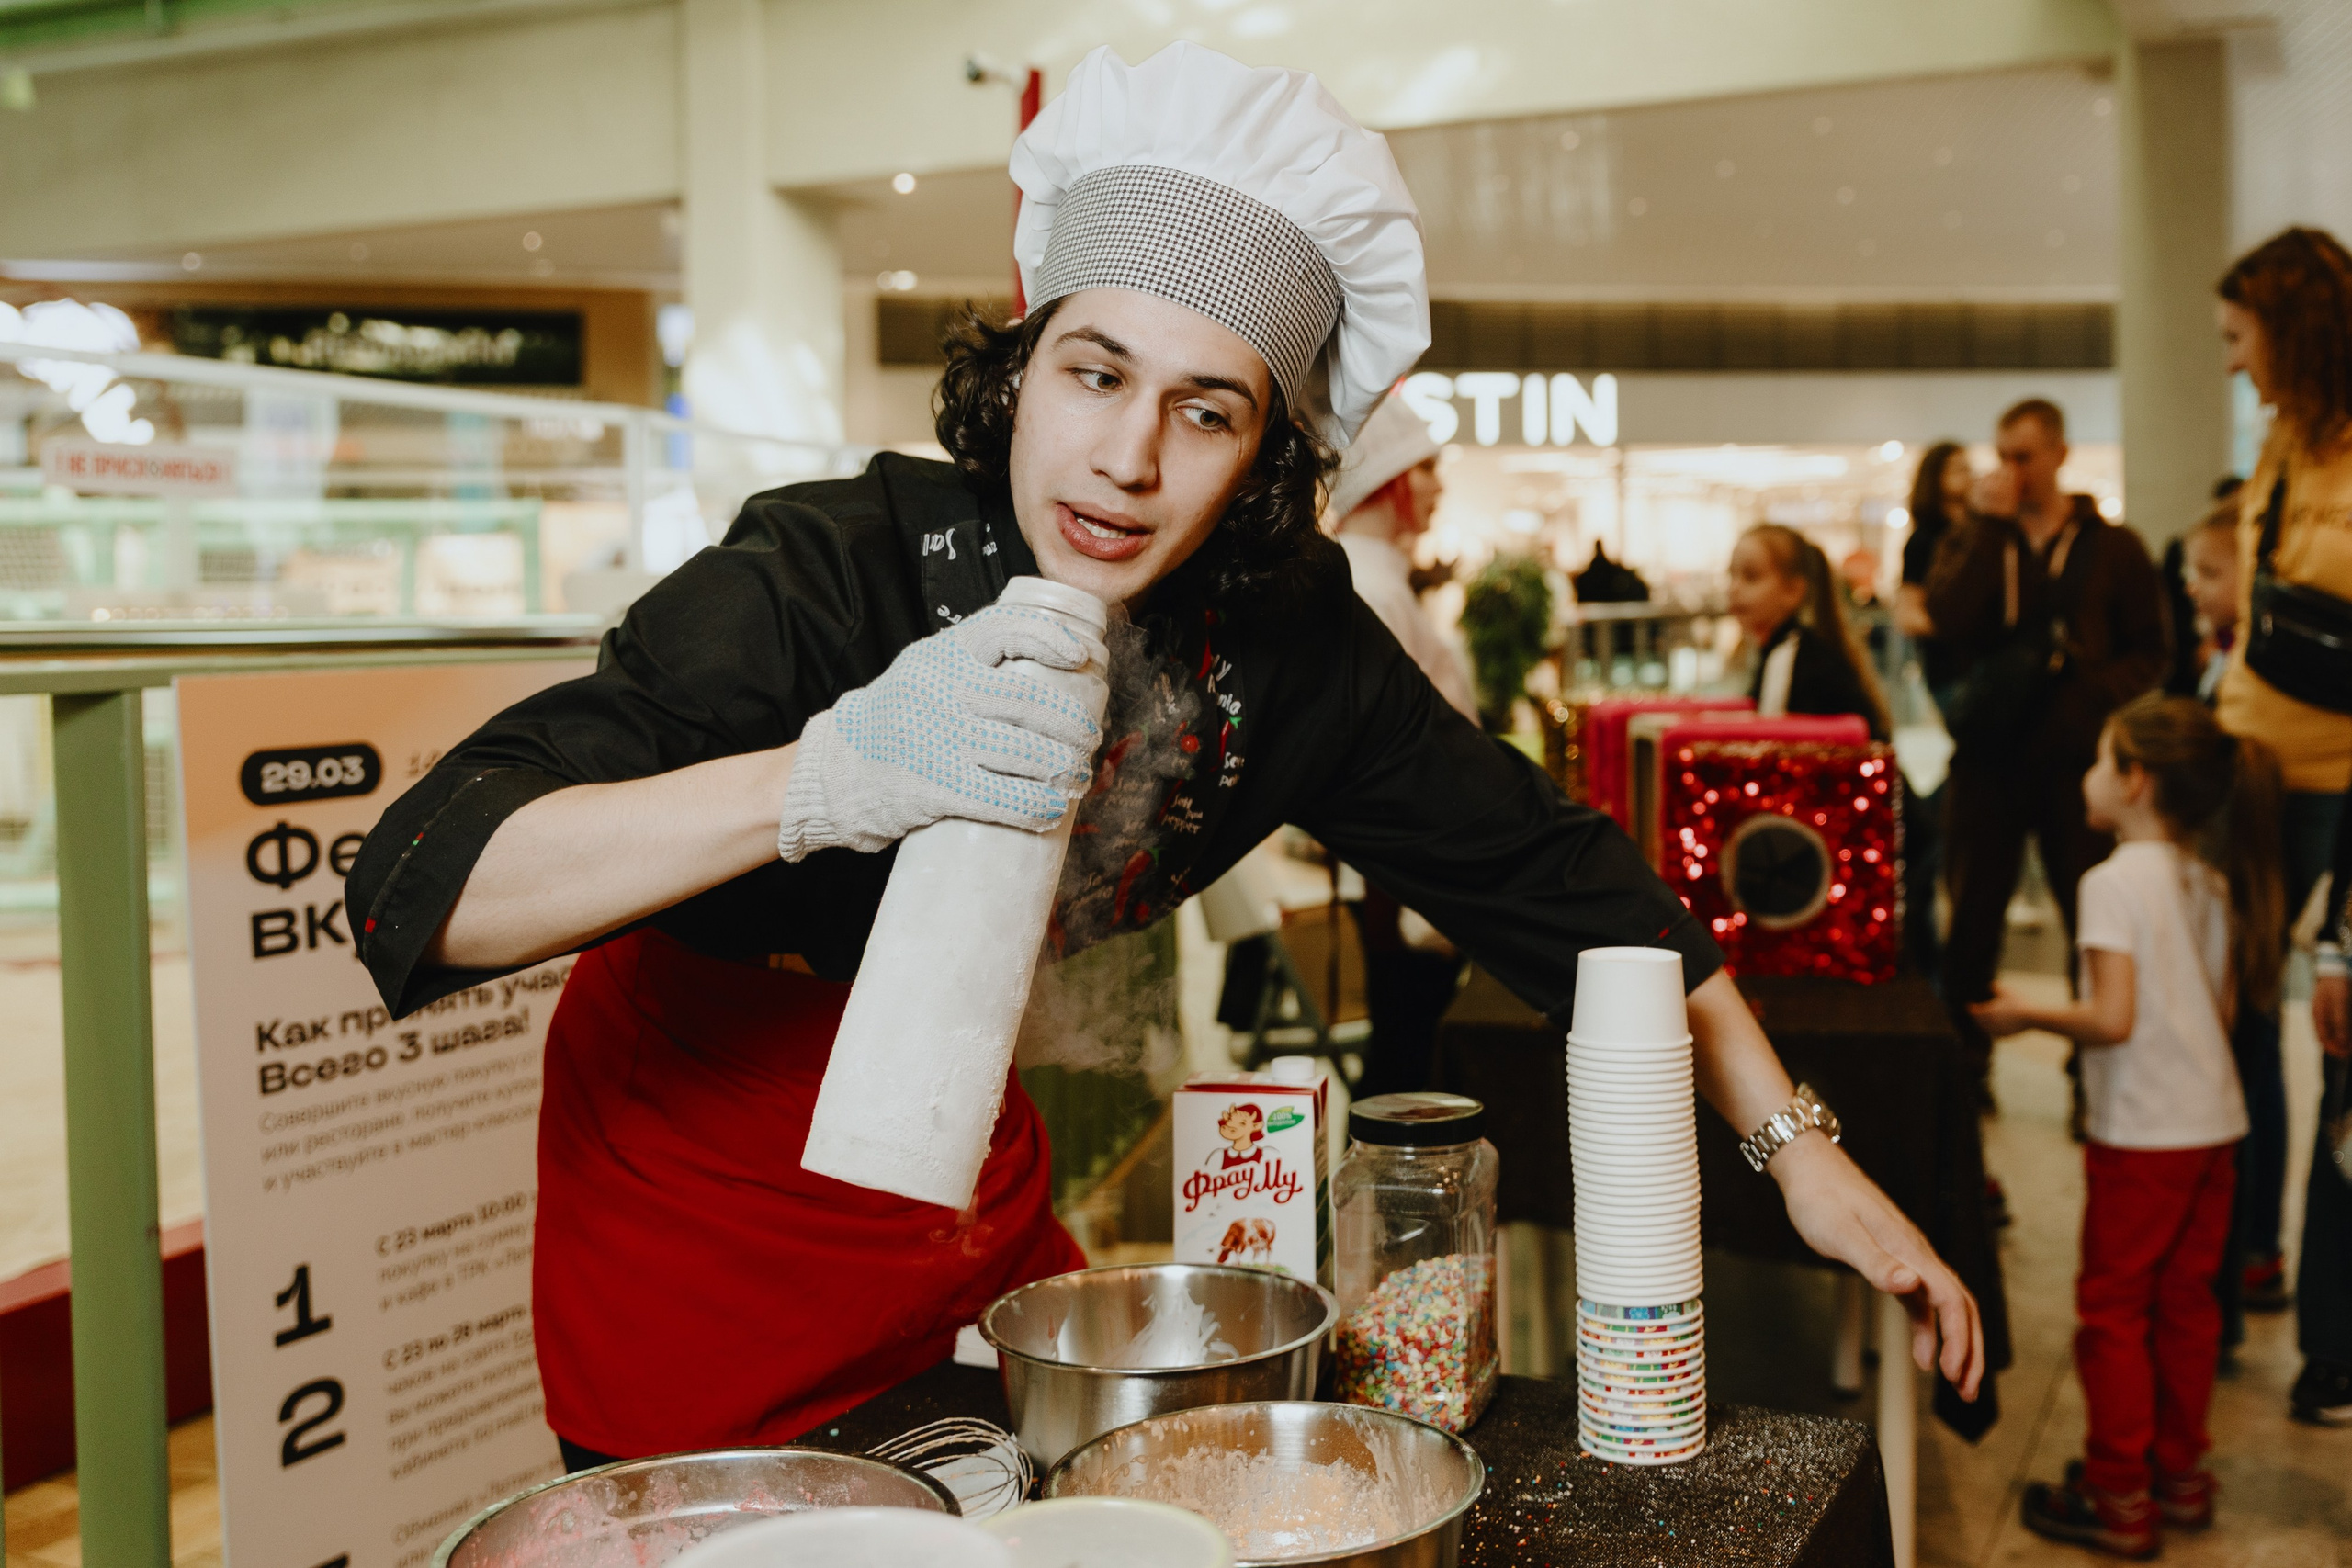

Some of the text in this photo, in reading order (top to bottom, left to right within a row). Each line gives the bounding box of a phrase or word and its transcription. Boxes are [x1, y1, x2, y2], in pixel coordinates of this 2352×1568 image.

[260, 755, 365, 794] 29.03
[254, 1017, 329, 1053] Как
[260, 1045, 389, 1096] Всего
[397, 1030, 422, 1064] 3
[1182, 1158, 1304, 1213] Фрау Му
[275, 1262, 334, 1348] 1
[278, 1375, 346, 1470] 2
